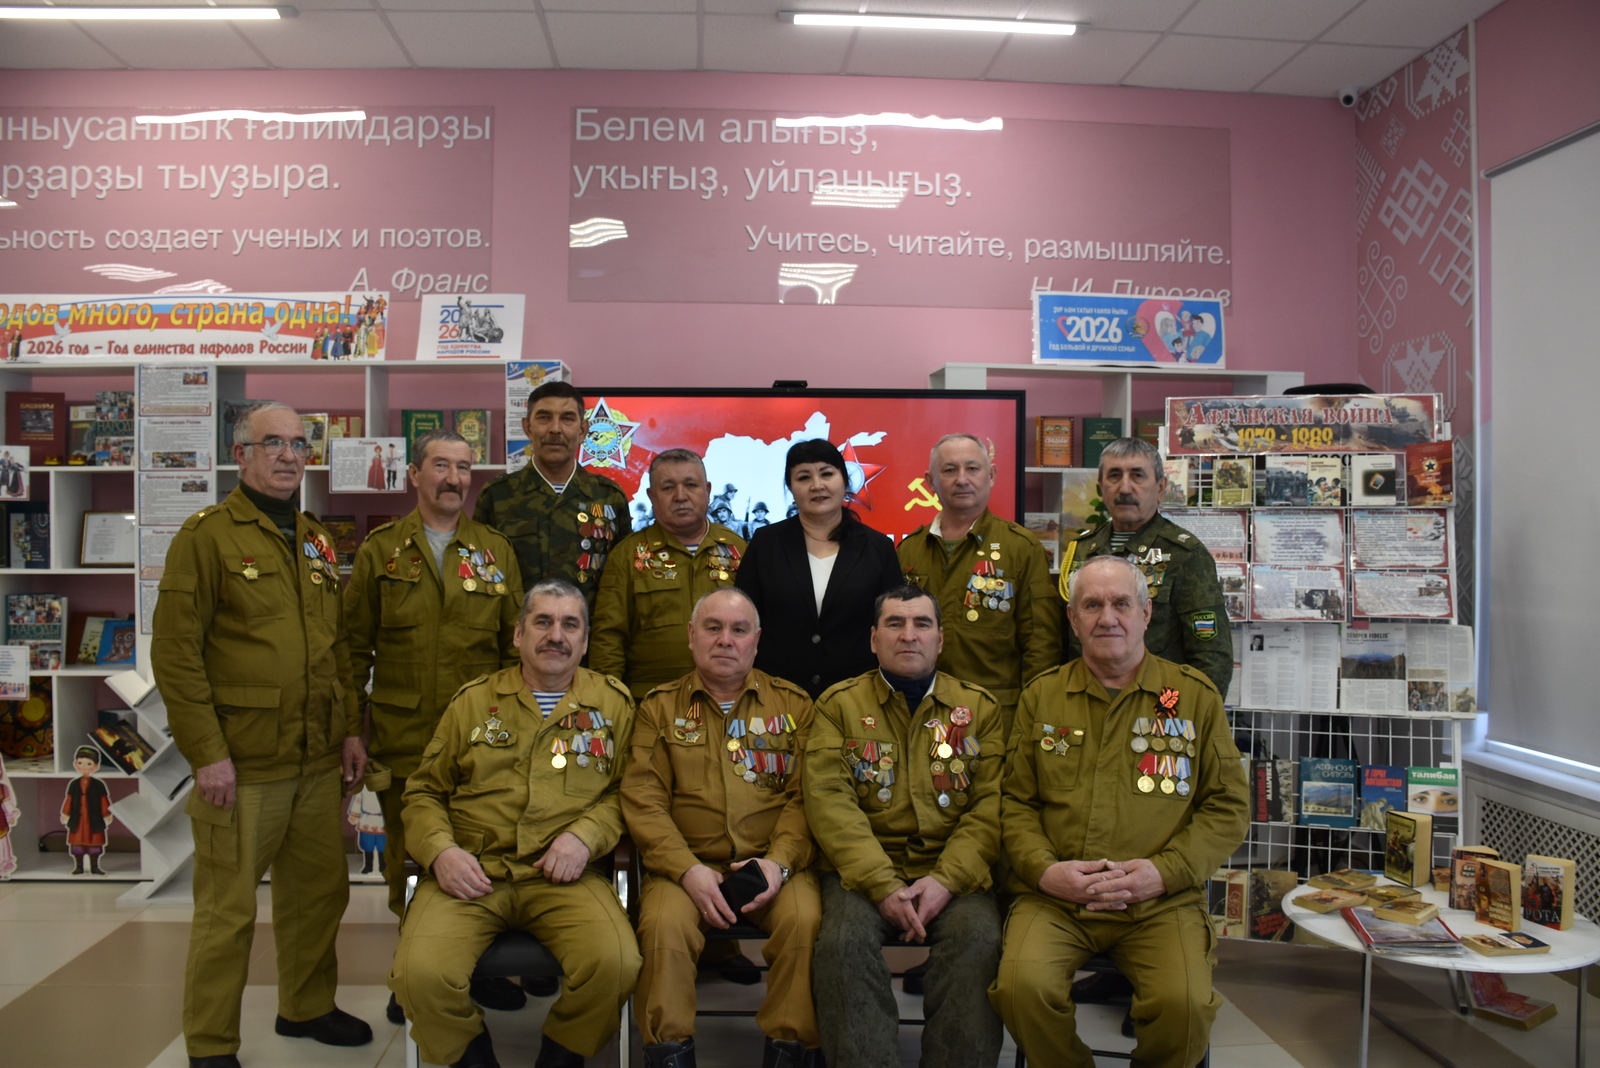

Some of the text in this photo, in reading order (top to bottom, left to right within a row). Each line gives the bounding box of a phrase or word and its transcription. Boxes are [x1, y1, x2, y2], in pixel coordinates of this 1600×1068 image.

[575, 108, 705, 142] Белем
[157, 163, 341, 200] тыуҙыра.
[572, 164, 729, 200] уҡығыҙ,
[104, 228, 224, 254] создает
[231, 227, 343, 256] ученых
[351, 228, 369, 249] и
[379, 227, 491, 249] поэтов.
[744, 225, 1233, 266] Учитесь, читайте, размышляйте.
[390, 266, 490, 300] Франс
[67, 301, 160, 333] много,
[169, 301, 264, 333] страна
[273, 294, 352, 330] одна!
[439, 308, 462, 325] 20
[438, 323, 460, 340] 26
[1065, 315, 1123, 344] 2026
[27, 340, 64, 355] 2026
[68, 344, 90, 356] год
[107, 341, 129, 355] Год
[133, 342, 196, 356] единства
[200, 343, 255, 358] народов
[259, 339, 308, 355] России
[1048, 342, 1060, 351] ГОД
[1060, 342, 1086, 352] БОЛЬШОЙ
[1091, 343, 1118, 352] ДРУЖНОЙ
[1291, 427, 1333, 451] 1989
[10, 624, 60, 635] НАРОДЫ
[1411, 771, 1456, 781] талибан
[1524, 908, 1562, 923] РОТА
